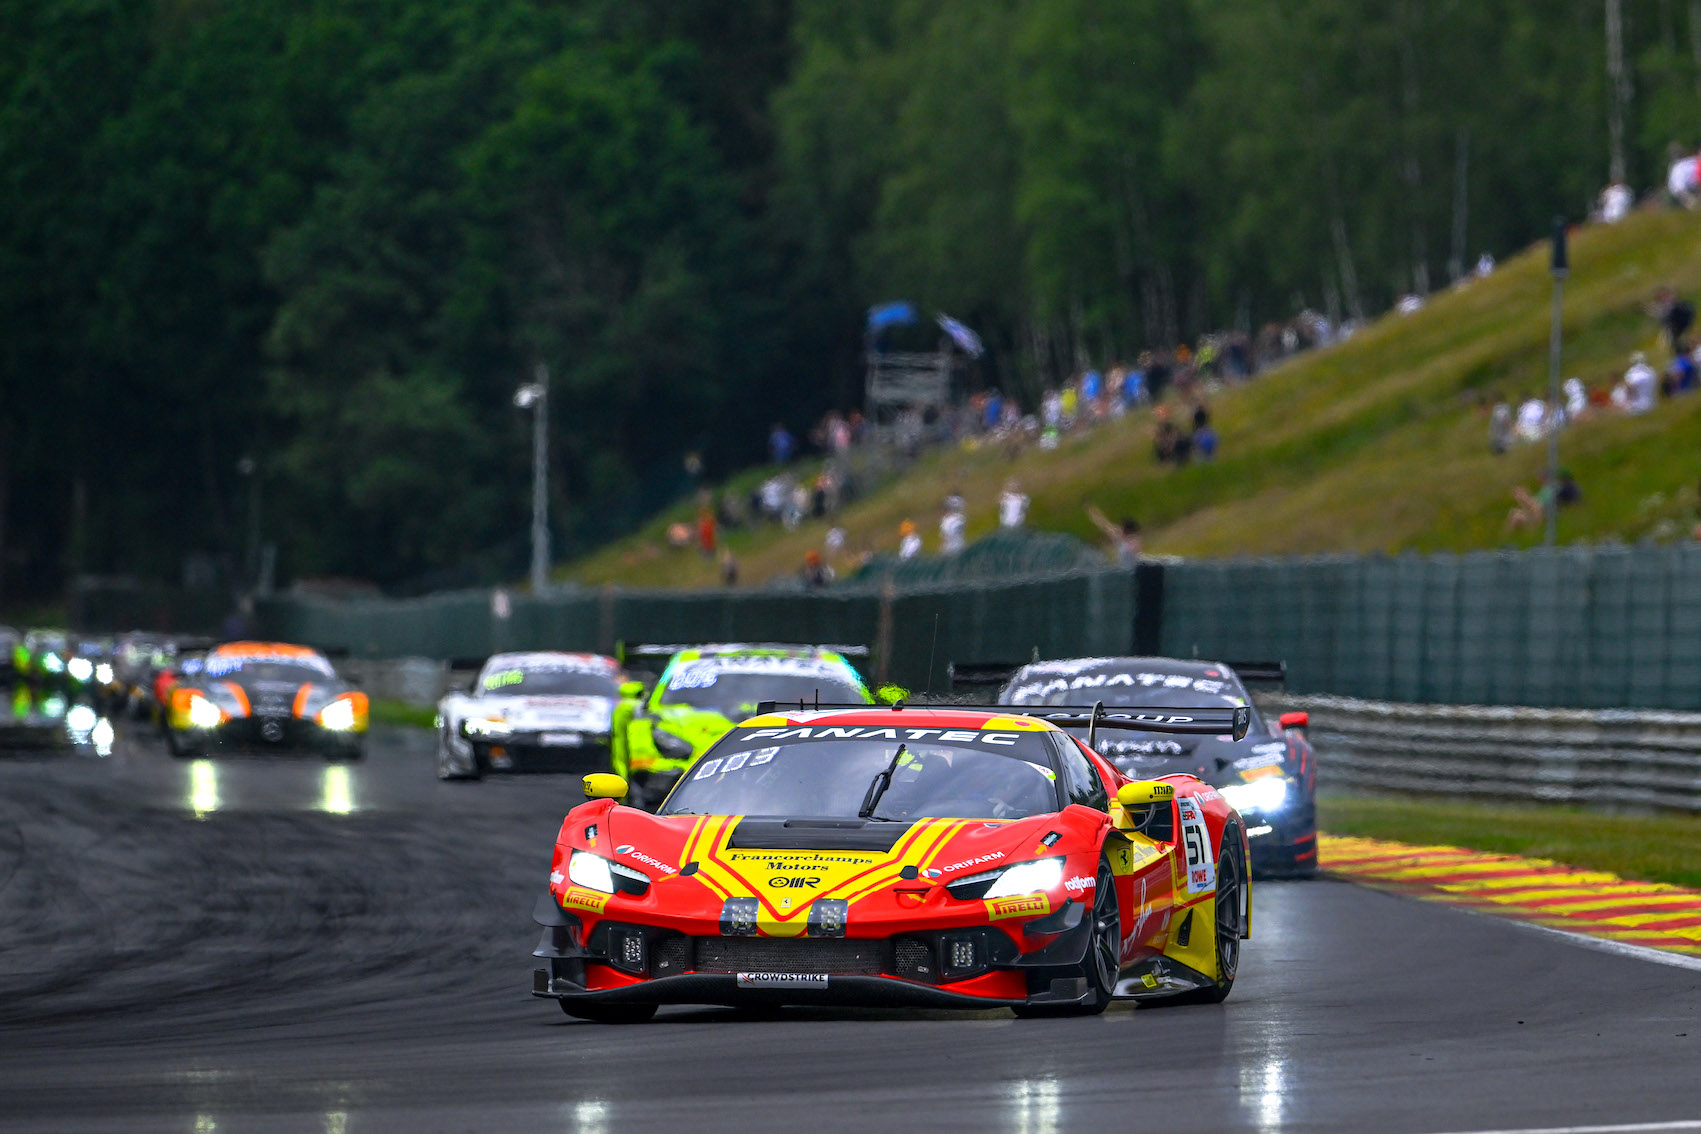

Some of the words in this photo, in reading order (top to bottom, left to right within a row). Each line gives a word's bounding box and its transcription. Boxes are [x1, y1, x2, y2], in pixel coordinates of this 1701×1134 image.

[740, 727, 1020, 745] FANATEC
[1184, 824, 1205, 866] 51
[631, 852, 677, 874] ORIFARM
[731, 854, 873, 864] Francorchamps
[766, 862, 829, 871] Motors
[943, 851, 1005, 872] ORIFARM
[1064, 876, 1096, 892] rotiform
[566, 890, 603, 909] PIRELLI
[992, 897, 1044, 915] PIRELLI
[747, 973, 825, 982] CROWDSTRIKE
